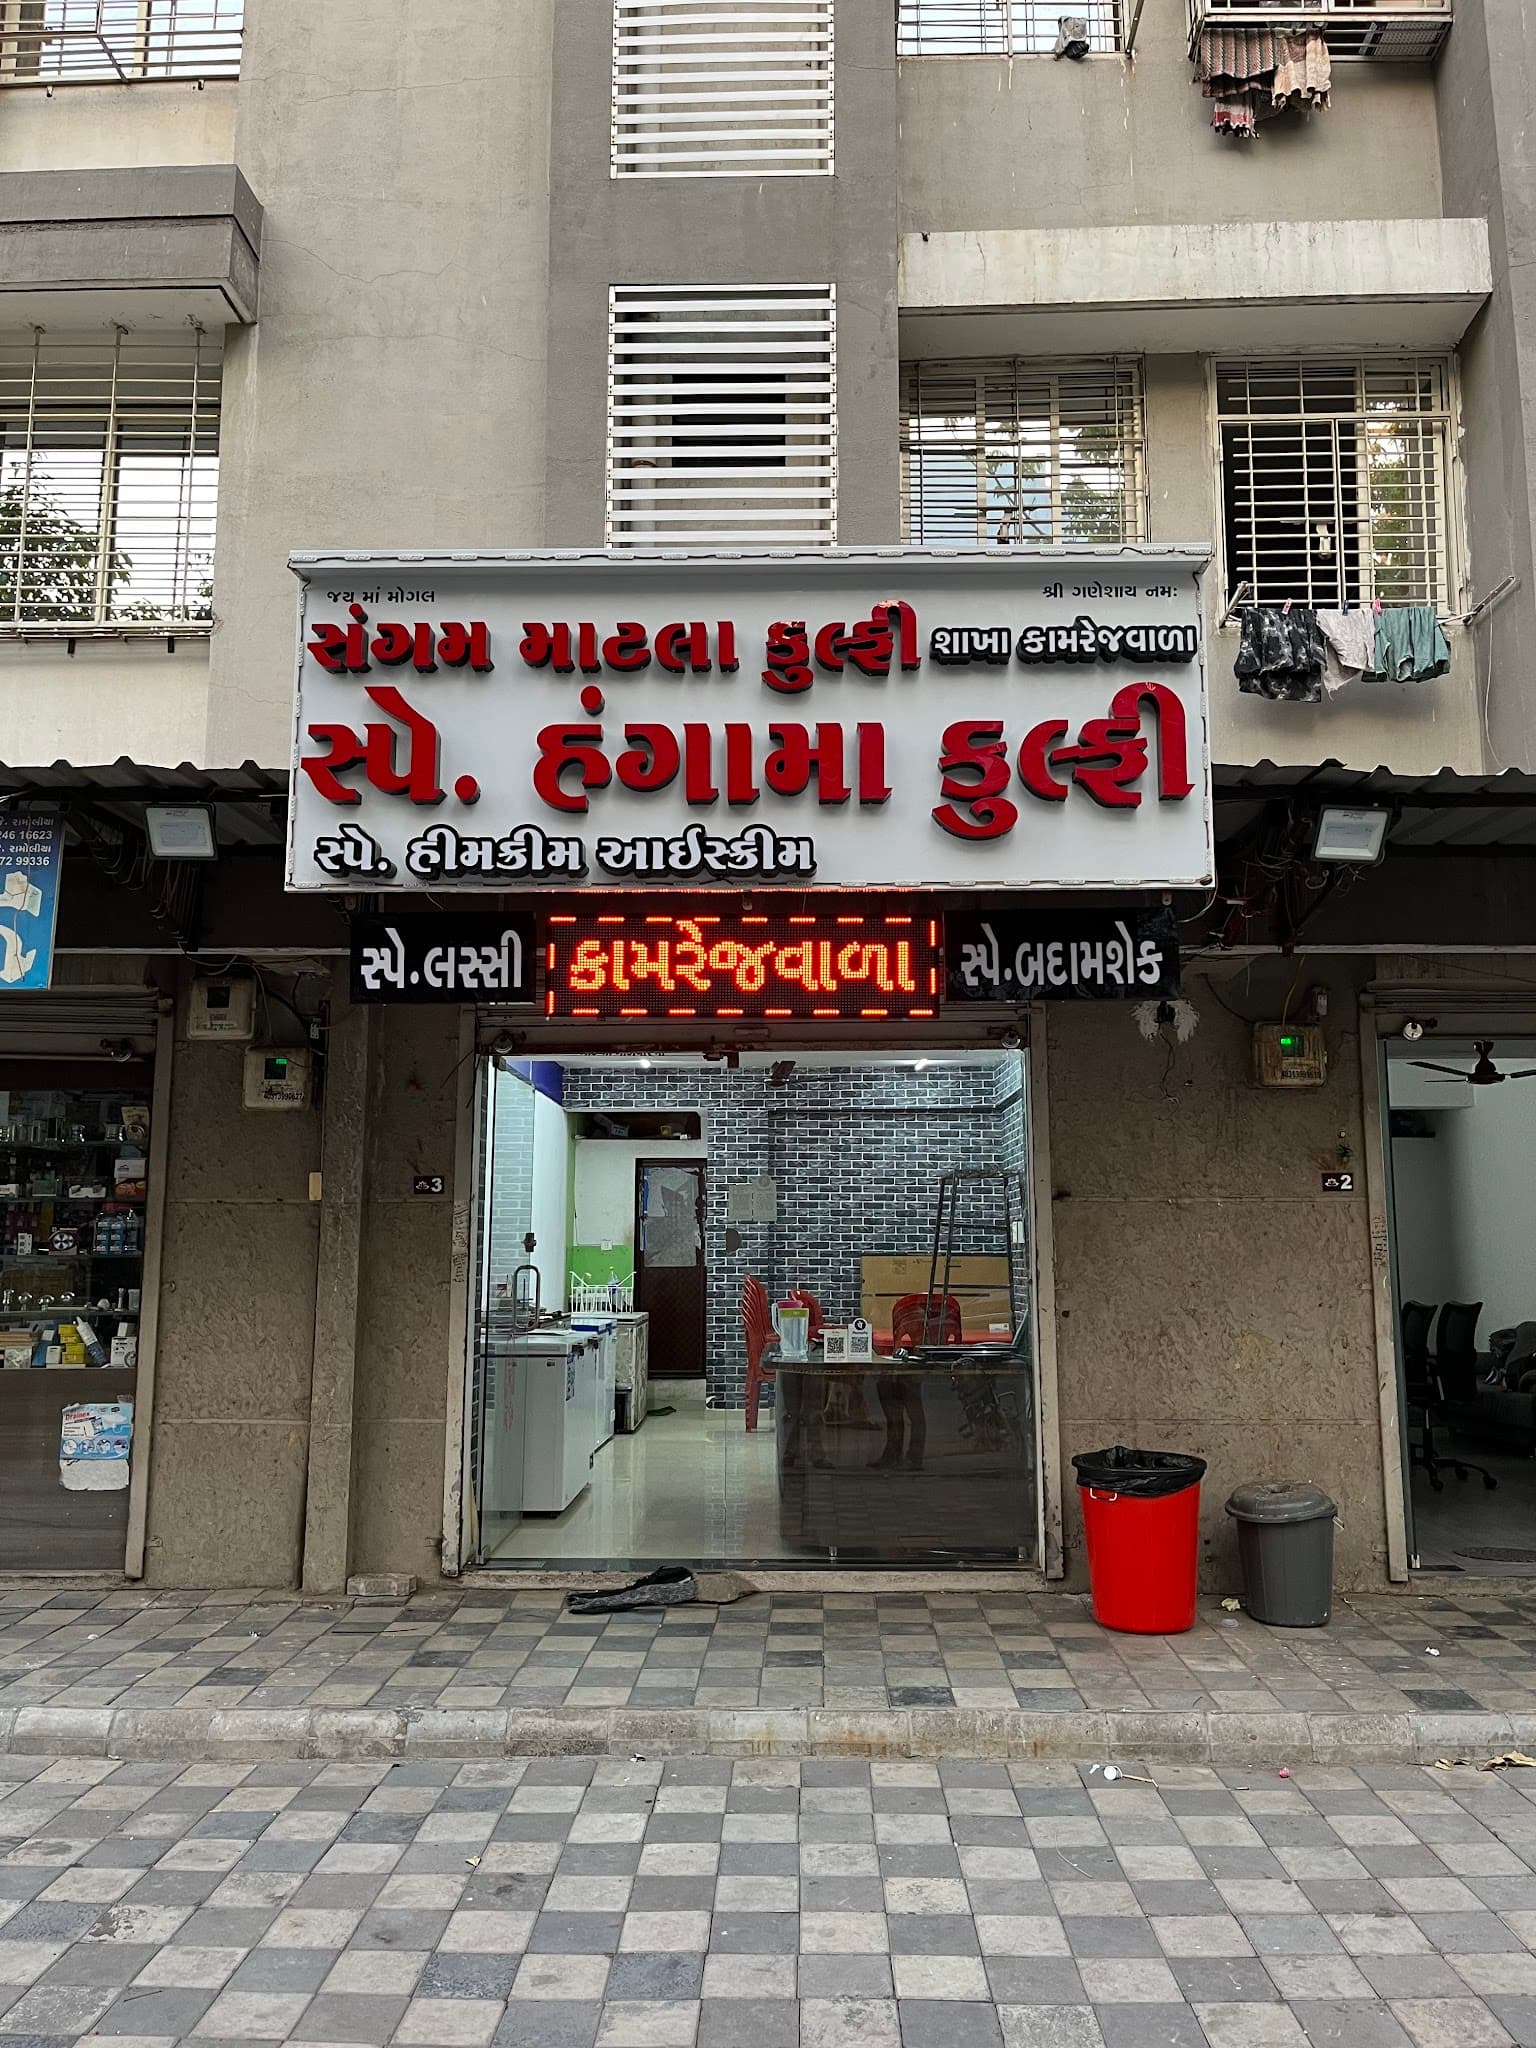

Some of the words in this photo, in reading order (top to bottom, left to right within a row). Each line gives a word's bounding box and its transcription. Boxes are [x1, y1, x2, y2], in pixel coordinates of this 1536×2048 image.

[327, 590, 355, 604] જય
[362, 586, 381, 604] માં
[387, 585, 436, 603] મોગલ
[1042, 582, 1064, 598] શ્રી
[1072, 581, 1137, 598] ગણેશાય
[307, 603, 493, 672] સંગમ
[519, 620, 740, 673] માટલા
[762, 599, 921, 693] કુલ્ફી
[931, 628, 1011, 659] શાખા
[1019, 617, 1197, 657] કામરેજવાળા
[301, 686, 480, 804] સ્પે.
[533, 685, 893, 812] હંગામા
[932, 681, 1196, 840] કુલ્ફી
[0, 830, 16, 840] 46
[19, 830, 53, 840] 16623
[315, 824, 392, 874] સ્પે.
[407, 825, 585, 875] હીમક્રીમ
[597, 824, 817, 873] આઈસ્ક્રીમ
[15, 856, 50, 866] 99336
[569, 919, 916, 992] કામરેજવાળા
[431, 1177, 443, 1193] 3
[1339, 1174, 1353, 1190] 2
